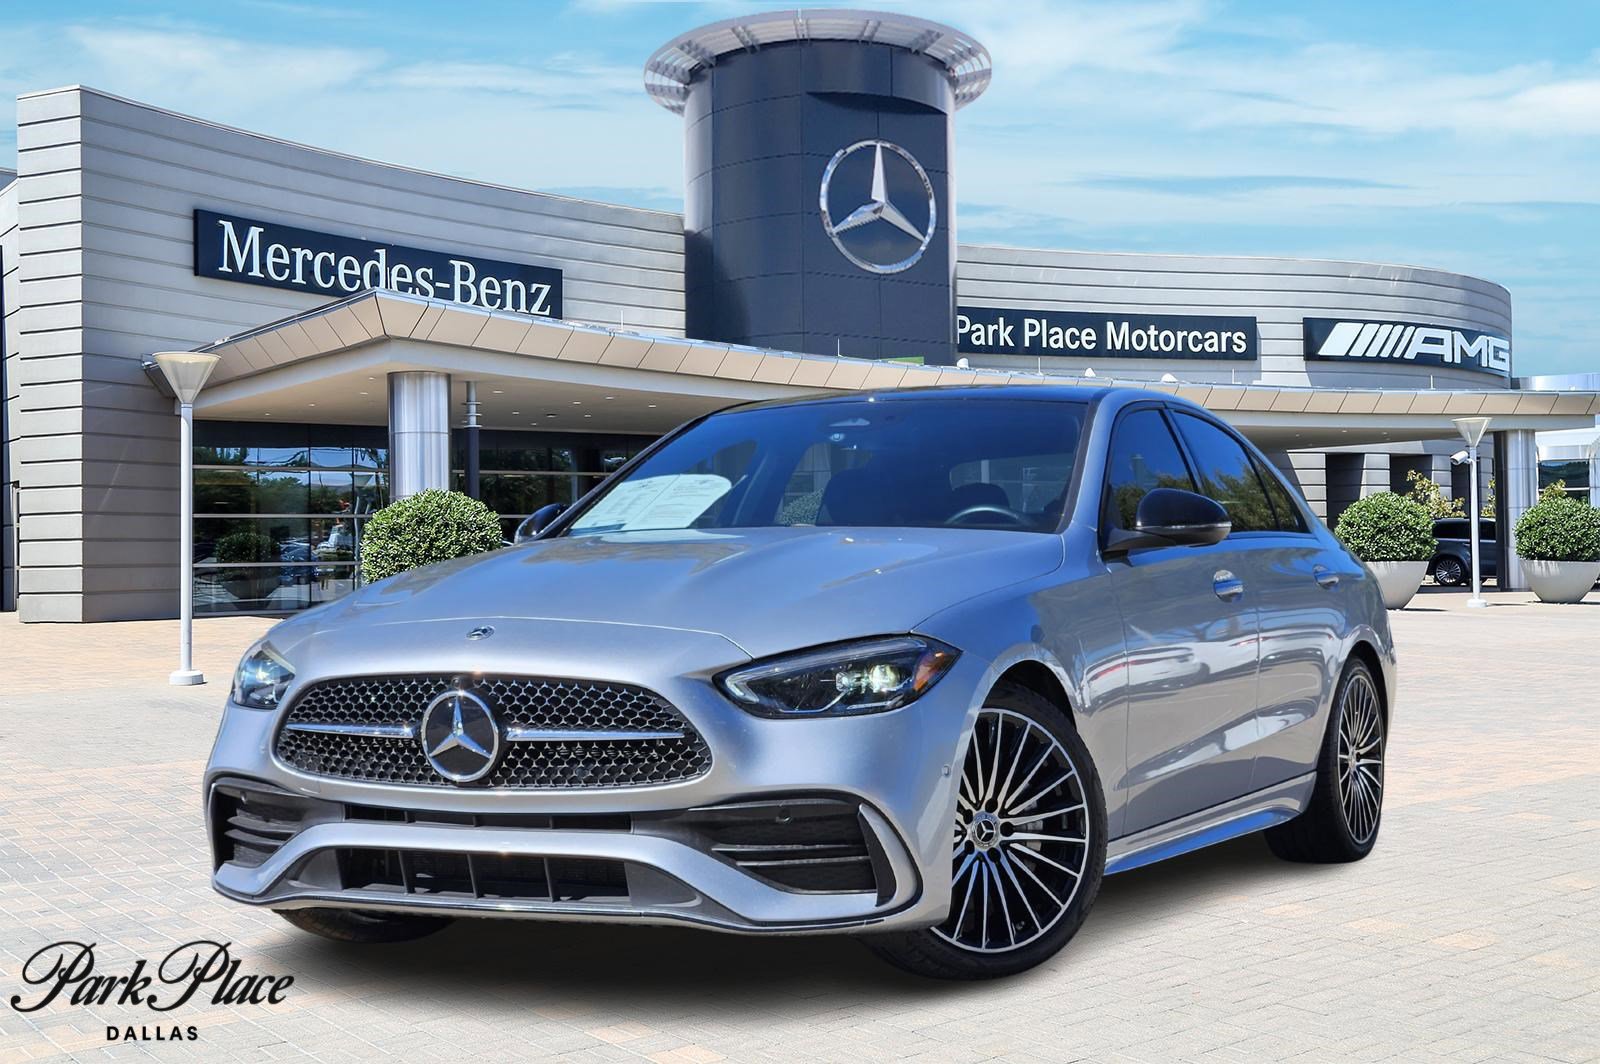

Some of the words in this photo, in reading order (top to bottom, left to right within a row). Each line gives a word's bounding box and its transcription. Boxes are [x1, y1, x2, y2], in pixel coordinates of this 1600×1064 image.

[218, 219, 552, 316] Mercedes-Benz
[957, 314, 1014, 348] Park
[1022, 317, 1096, 351] Place
[1106, 320, 1247, 354] Motorcars
